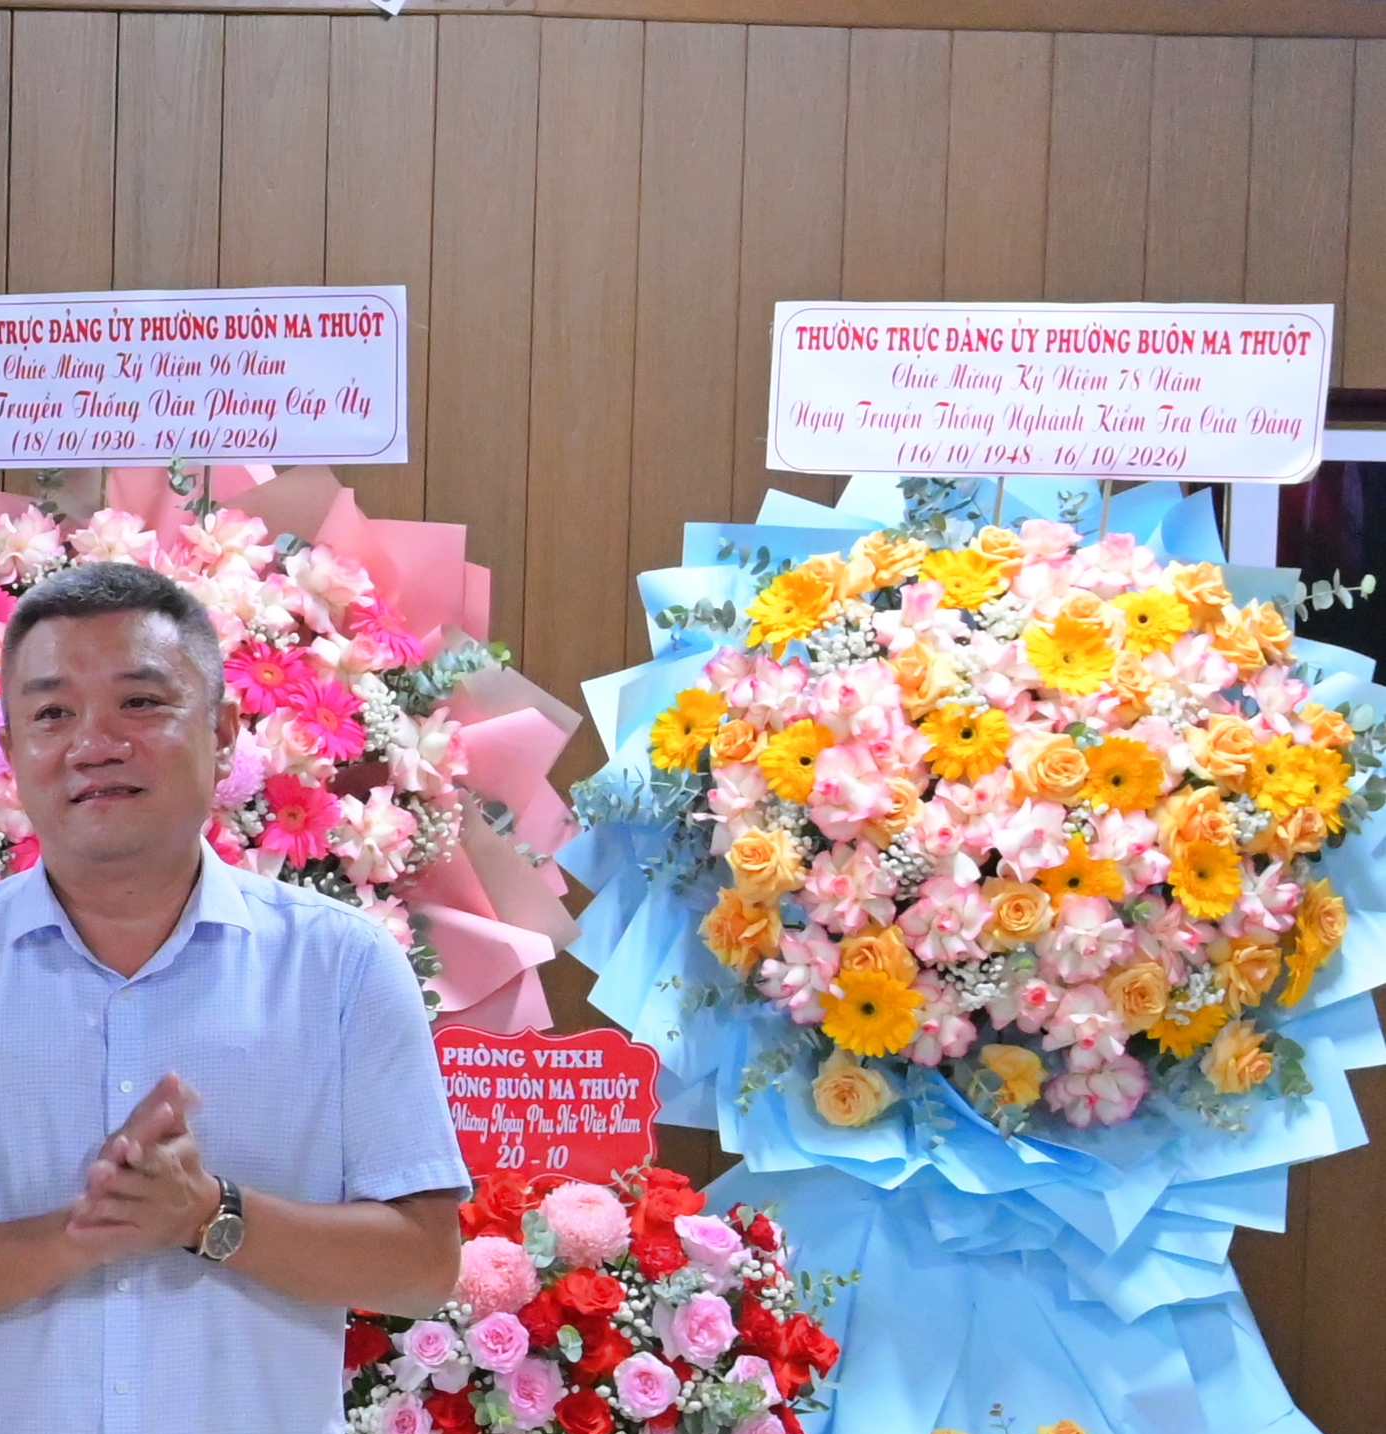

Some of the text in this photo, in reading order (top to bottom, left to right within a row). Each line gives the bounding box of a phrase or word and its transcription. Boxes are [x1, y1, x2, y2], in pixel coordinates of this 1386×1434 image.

[49, 308, 102, 343] ĐẢNG
[108, 307, 135, 342] ỦY
[140, 308, 219, 341] PHƯỜNG
[224, 307, 278, 340] BUÔN
[284, 313, 313, 339] MA
[319, 305, 384, 344] THUỘT
[796, 317, 1312, 363] THƯỜNG TRỰC ĐẢNG ỦY PHƯỜNG BUÔN MA THUỘT
[3, 354, 47, 381] Chúc
[51, 353, 105, 384] Mừng
[150, 350, 202, 382] Niệm
[210, 352, 231, 377] 96
[237, 350, 286, 376] Năm
[892, 362, 939, 389] Chúc
[944, 363, 1003, 396] Mừng
[1053, 364, 1107, 396] Niệm
[1118, 368, 1143, 392] 78
[1149, 364, 1201, 391] Năm
[73, 390, 141, 424] Thống
[148, 388, 196, 417] Văn
[204, 387, 279, 421] Phòng
[286, 386, 326, 421] Cấp
[335, 377, 371, 420] Ủy
[1158, 404, 1192, 433] Tra
[1200, 405, 1237, 434] Của
[1246, 406, 1302, 441] Đảng
[442, 1043, 603, 1068] PHÒNG VHXH
[443, 1070, 491, 1099] ƯỜNG
[496, 1072, 544, 1099] BUÔN
[548, 1078, 575, 1100] MA
[491, 1103, 524, 1144] Ngày
[527, 1104, 554, 1140] Phụ
[580, 1104, 607, 1140] Việt
[609, 1104, 640, 1135] Nam
[496, 1145, 525, 1169] 20
[545, 1145, 569, 1169] 10
